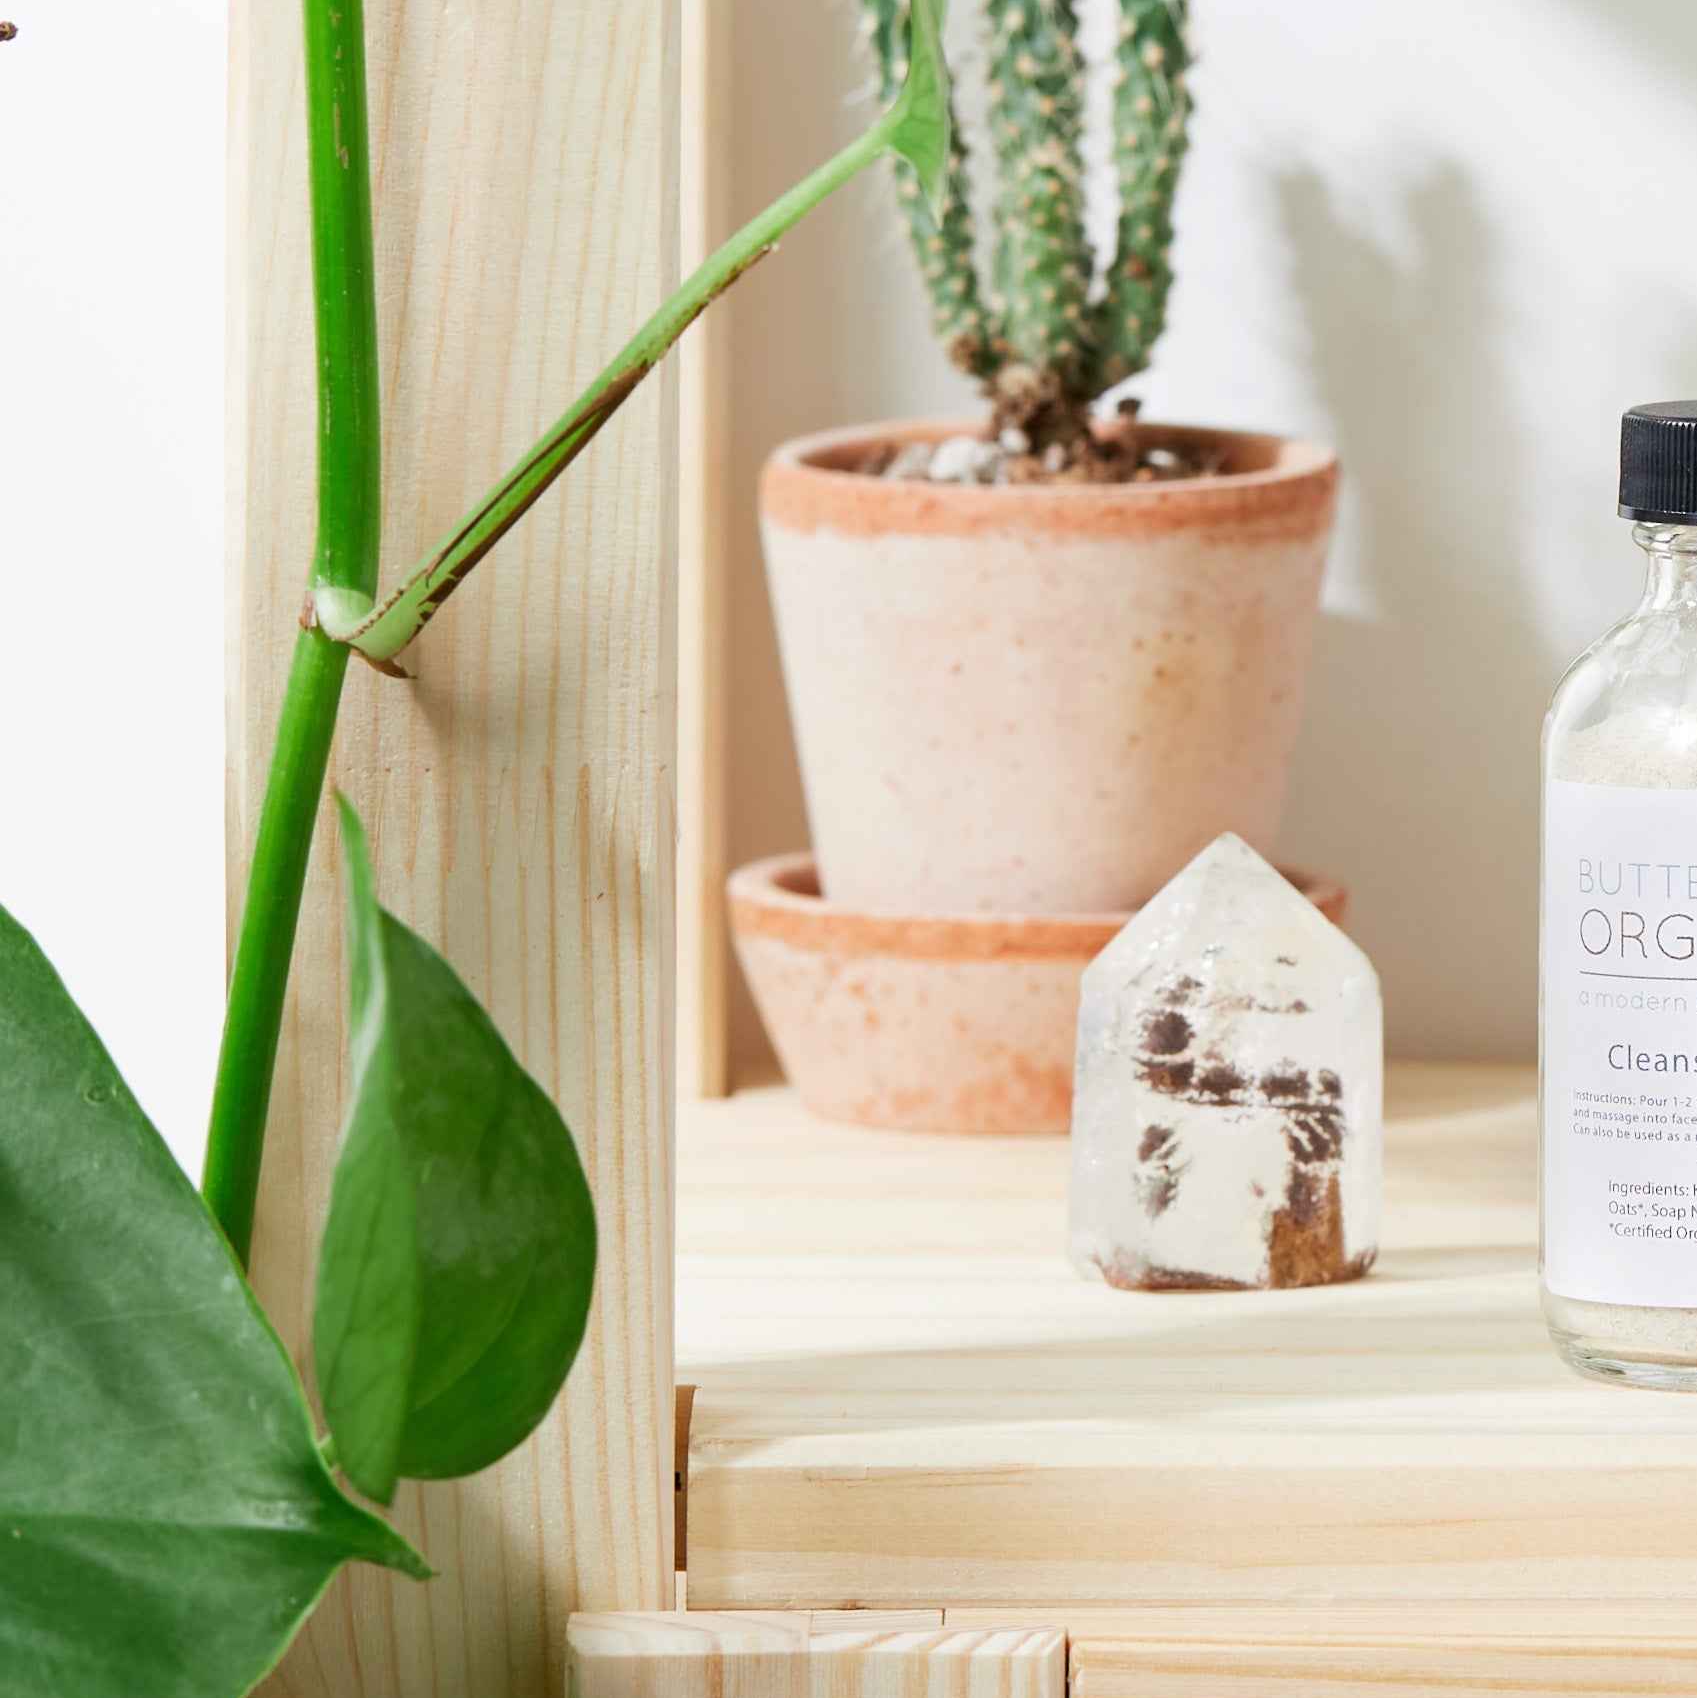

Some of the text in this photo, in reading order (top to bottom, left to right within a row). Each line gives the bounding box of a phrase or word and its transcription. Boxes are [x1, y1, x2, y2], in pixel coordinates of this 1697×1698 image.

[1594, 990, 1688, 1012] modern
[1640, 1094, 1667, 1106] Pour
[1673, 1096, 1692, 1108] 1-2
[1573, 1107, 1590, 1119] and
[1592, 1111, 1639, 1125] massage
[1643, 1112, 1668, 1125] into
[1672, 1113, 1697, 1125] face
[1572, 1122, 1590, 1135] Can
[1592, 1125, 1613, 1138] also
[1616, 1127, 1631, 1139] be
[1634, 1129, 1662, 1141] used
[1667, 1131, 1680, 1142] as
[1608, 1180, 1690, 1198] Ingredients:
[1651, 1204, 1687, 1221] Soap
